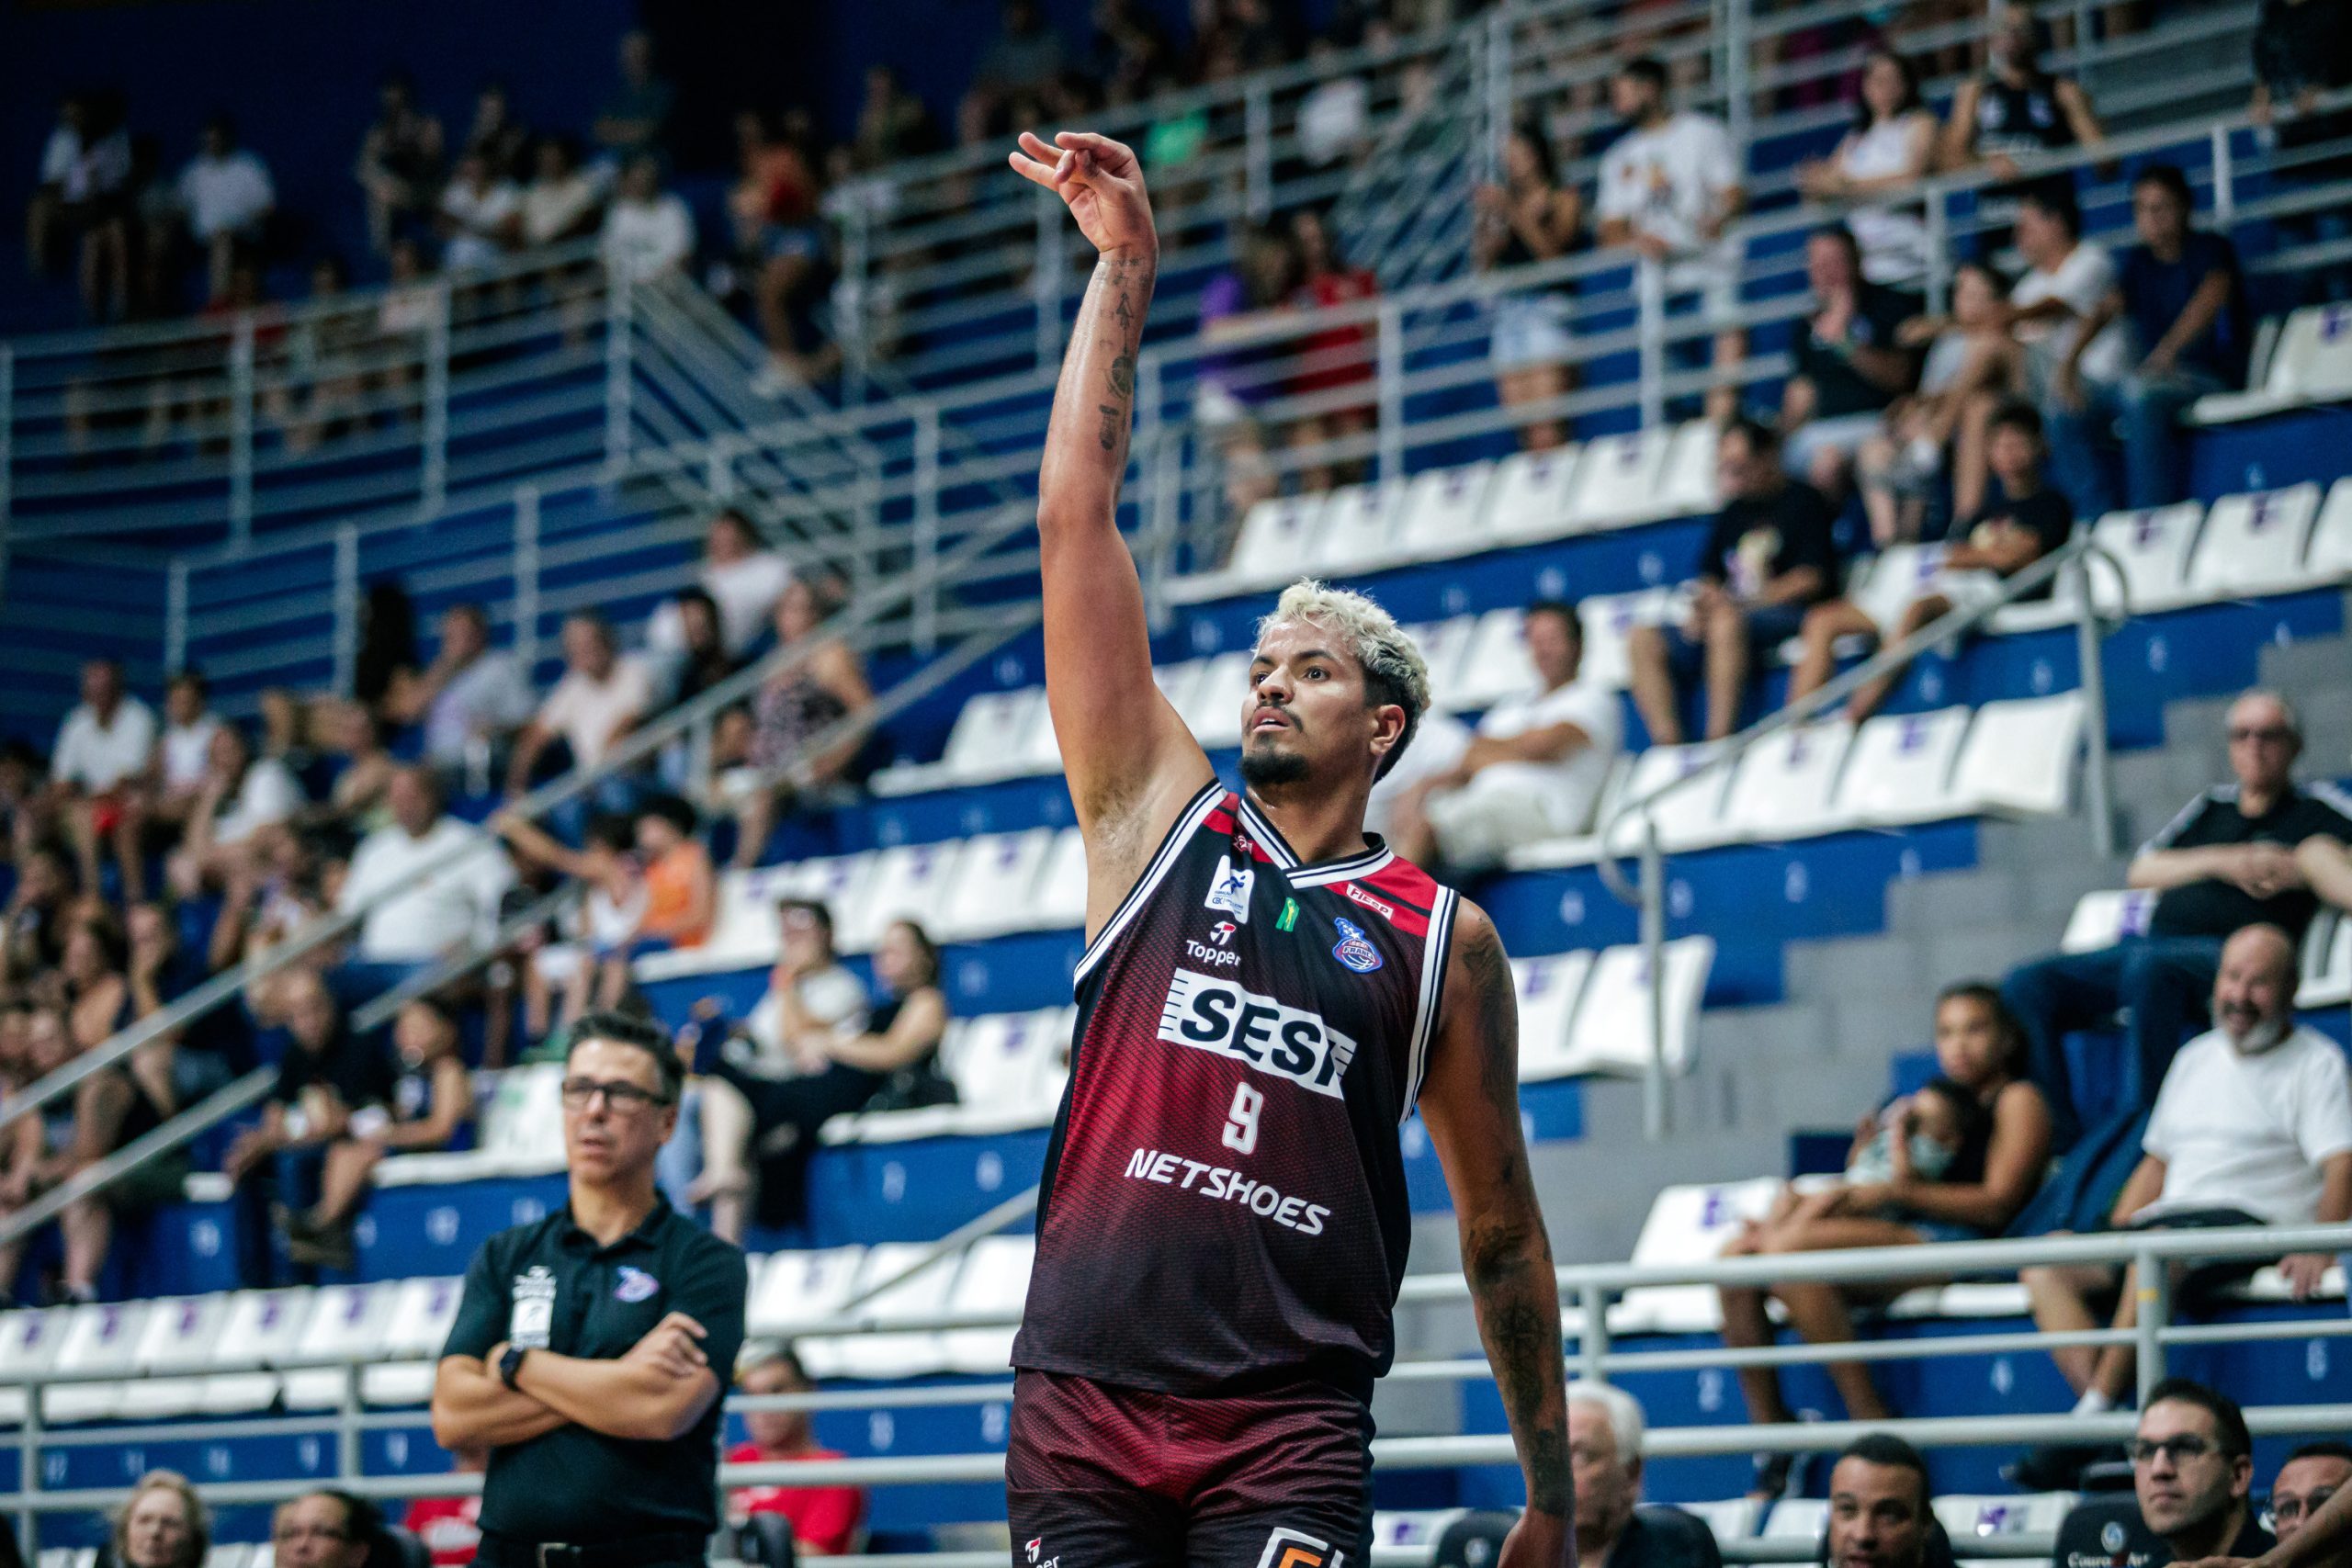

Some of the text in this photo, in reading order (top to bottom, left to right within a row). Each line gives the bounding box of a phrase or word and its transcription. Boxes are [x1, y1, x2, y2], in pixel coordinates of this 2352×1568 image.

[1186, 939, 1241, 966] Topper
[1180, 988, 1337, 1087] SESI
[1221, 1082, 1263, 1155] 9
[1124, 1147, 1331, 1235] NETSHOES
